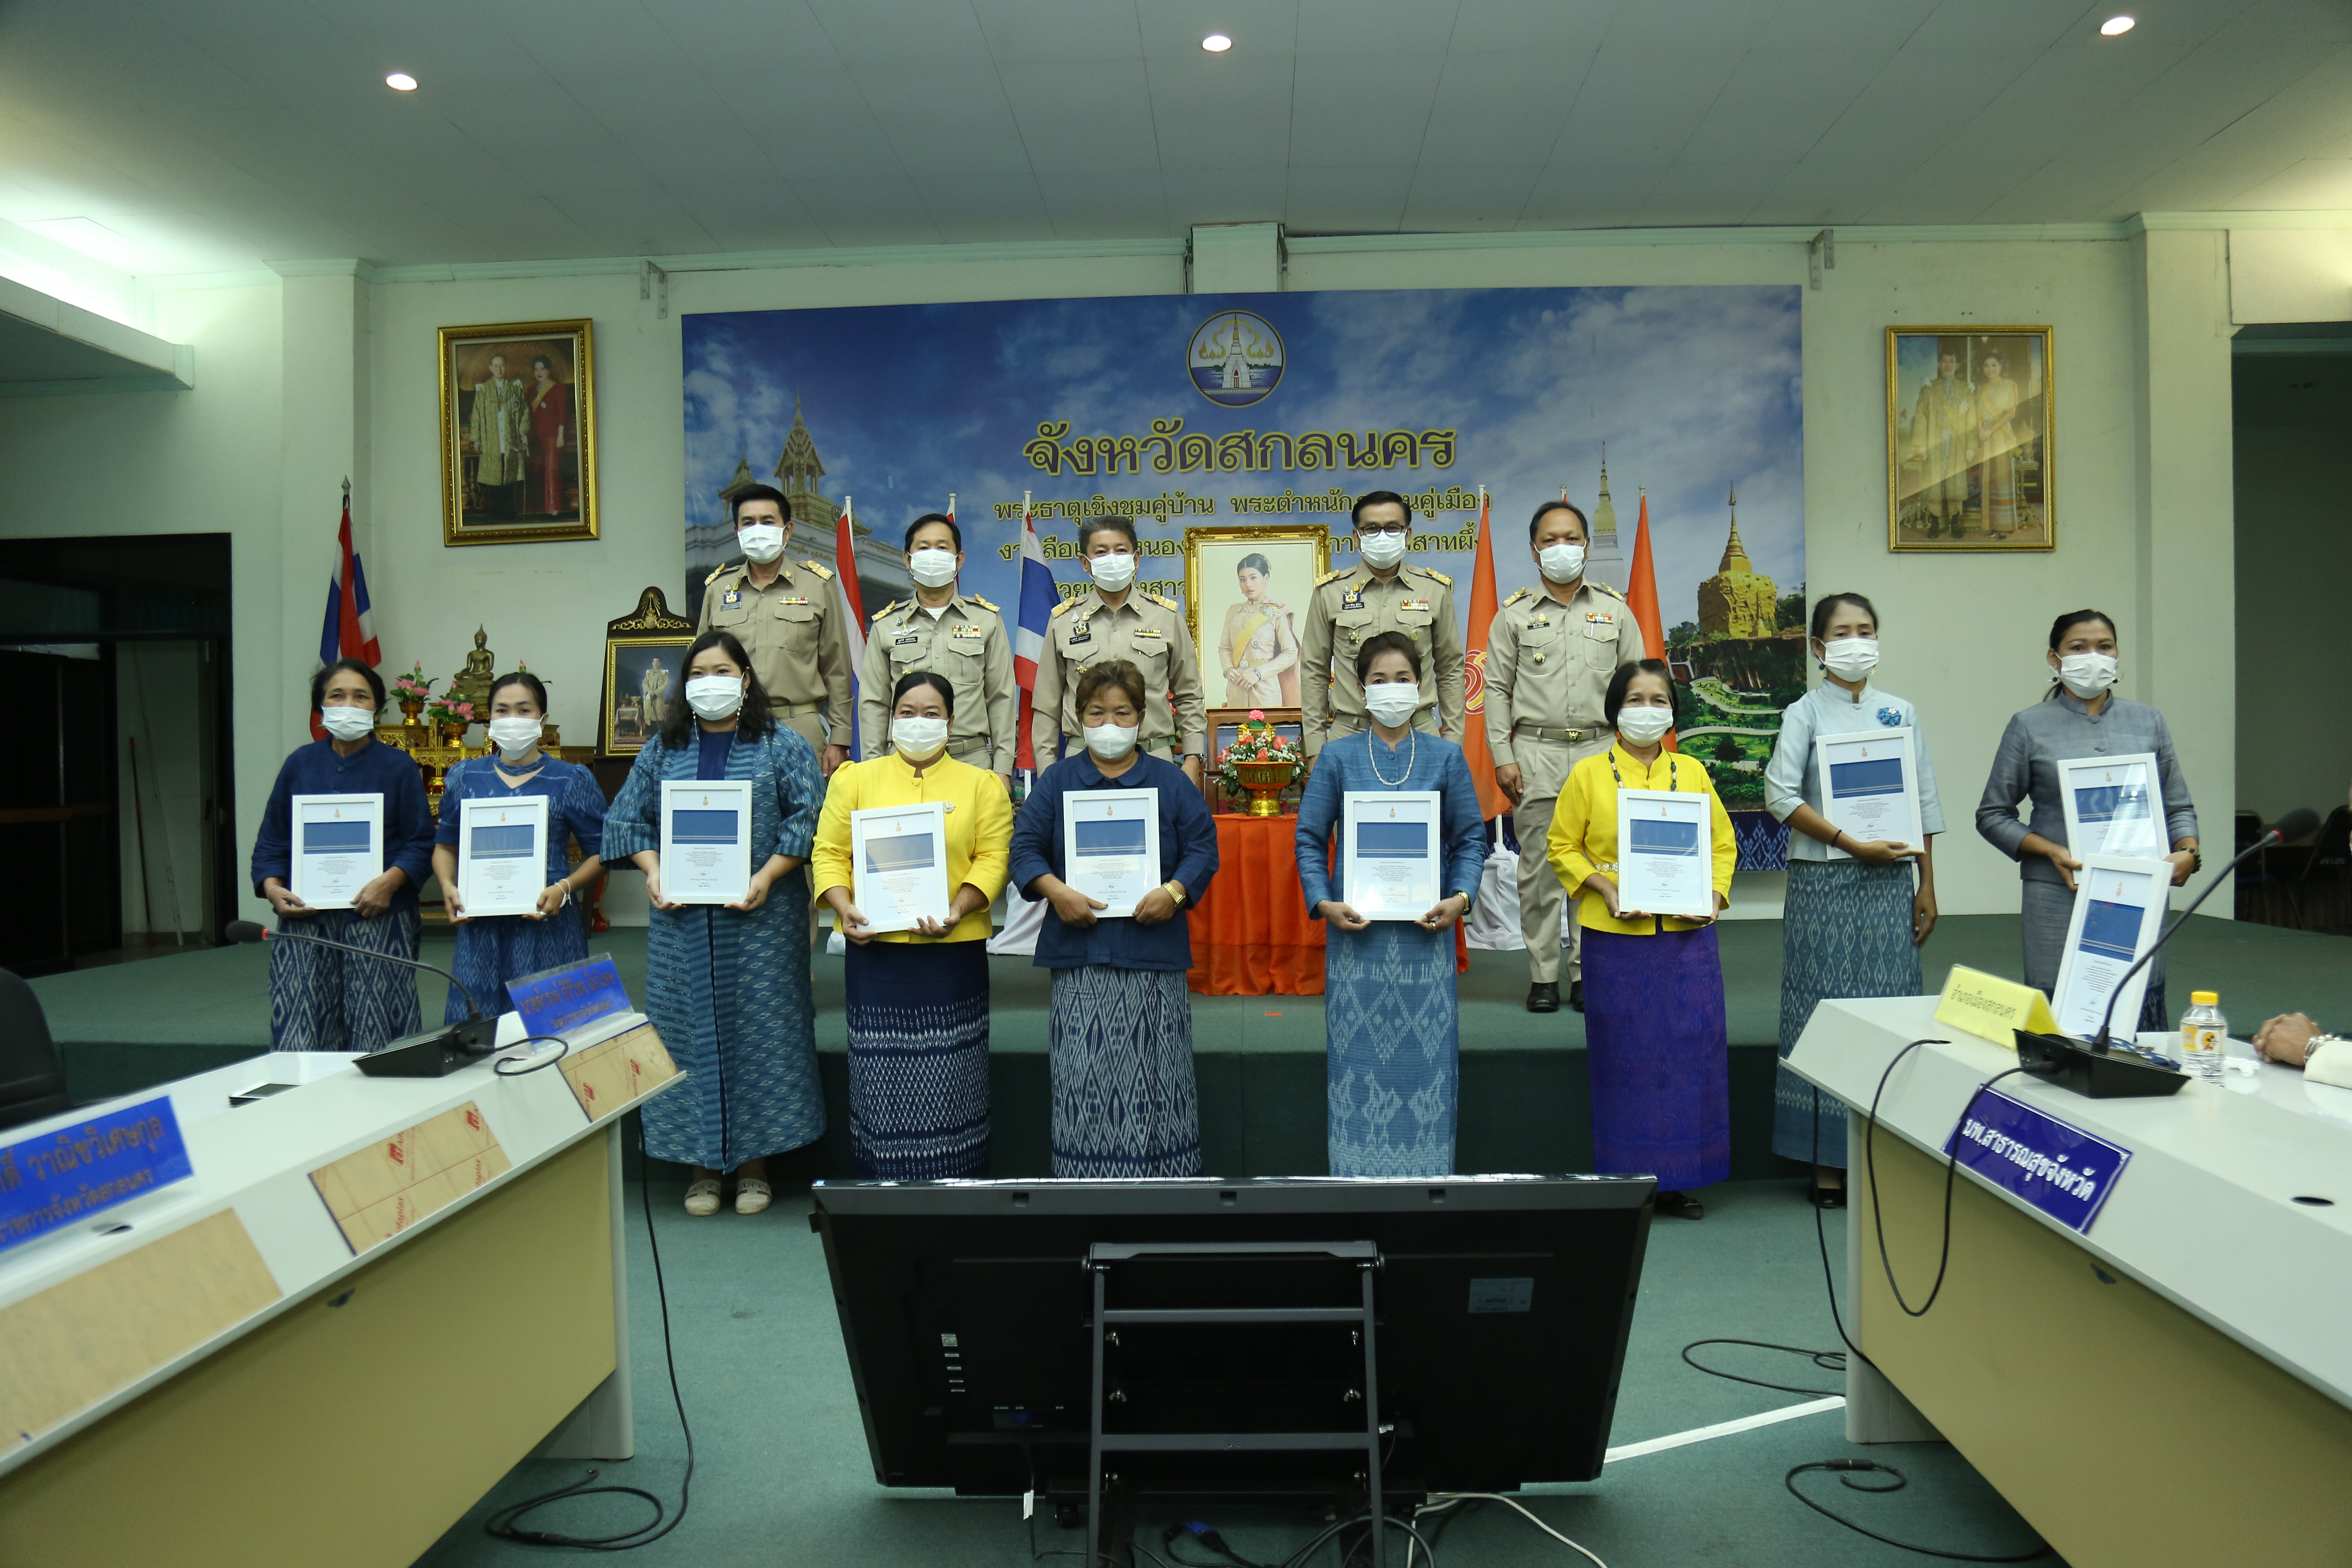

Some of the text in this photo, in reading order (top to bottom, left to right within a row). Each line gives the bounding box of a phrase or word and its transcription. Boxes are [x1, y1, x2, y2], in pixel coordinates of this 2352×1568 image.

[1024, 417, 1457, 476] จังหวัดสกลนคร
[994, 491, 1214, 526] พระธาตุเชิงชุมคู่บ้าน
[1950, 984, 2017, 1020] อำเภอเมืองสกลนคร
[1961, 1119, 2097, 1202] นพ.สาธารณสุขจังหวัด
